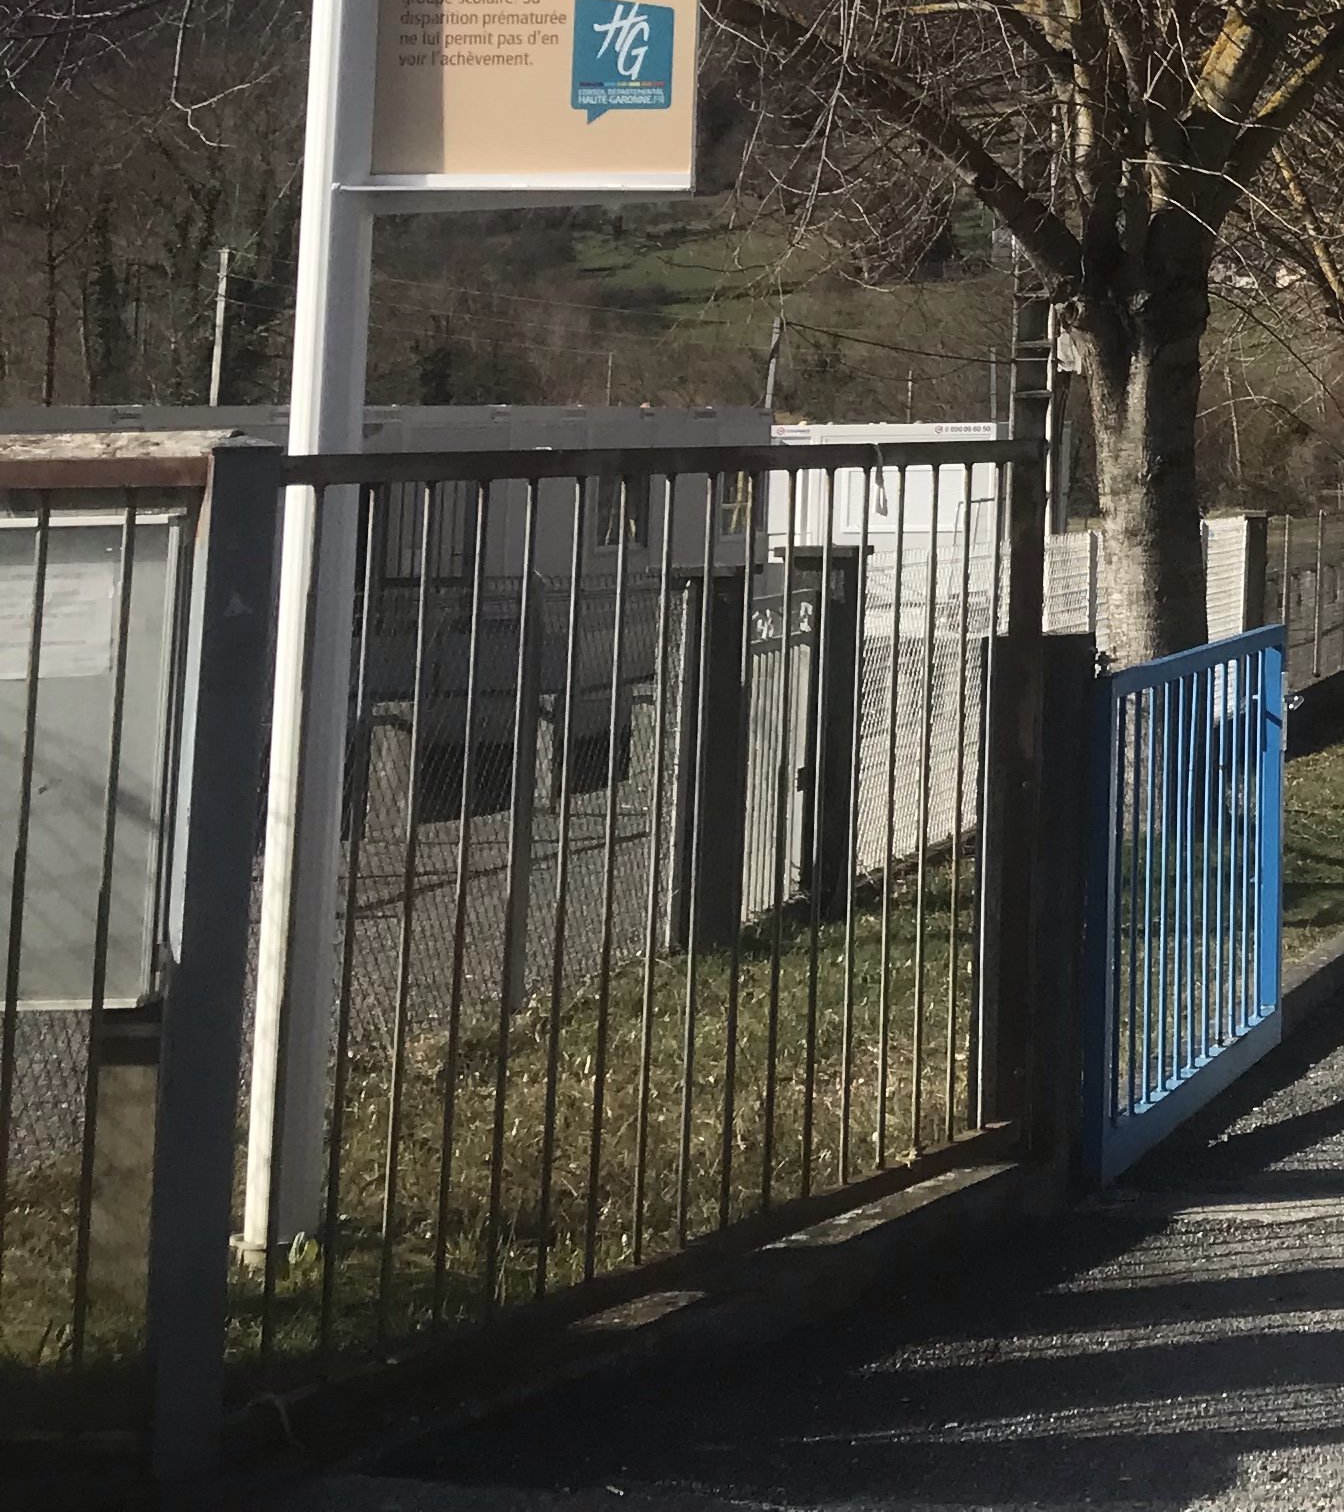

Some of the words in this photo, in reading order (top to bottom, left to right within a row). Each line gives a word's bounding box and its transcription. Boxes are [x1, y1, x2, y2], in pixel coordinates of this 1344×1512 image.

[400, 10, 478, 28] disparition
[482, 10, 568, 28] prématurée
[399, 33, 418, 45] ne
[422, 31, 440, 45] lui
[444, 31, 494, 48] permit
[497, 34, 523, 48] pas
[527, 30, 560, 45] d'en
[593, 2, 650, 81] HG
[399, 52, 427, 66] voir
[431, 51, 534, 66] l'achèvement.
